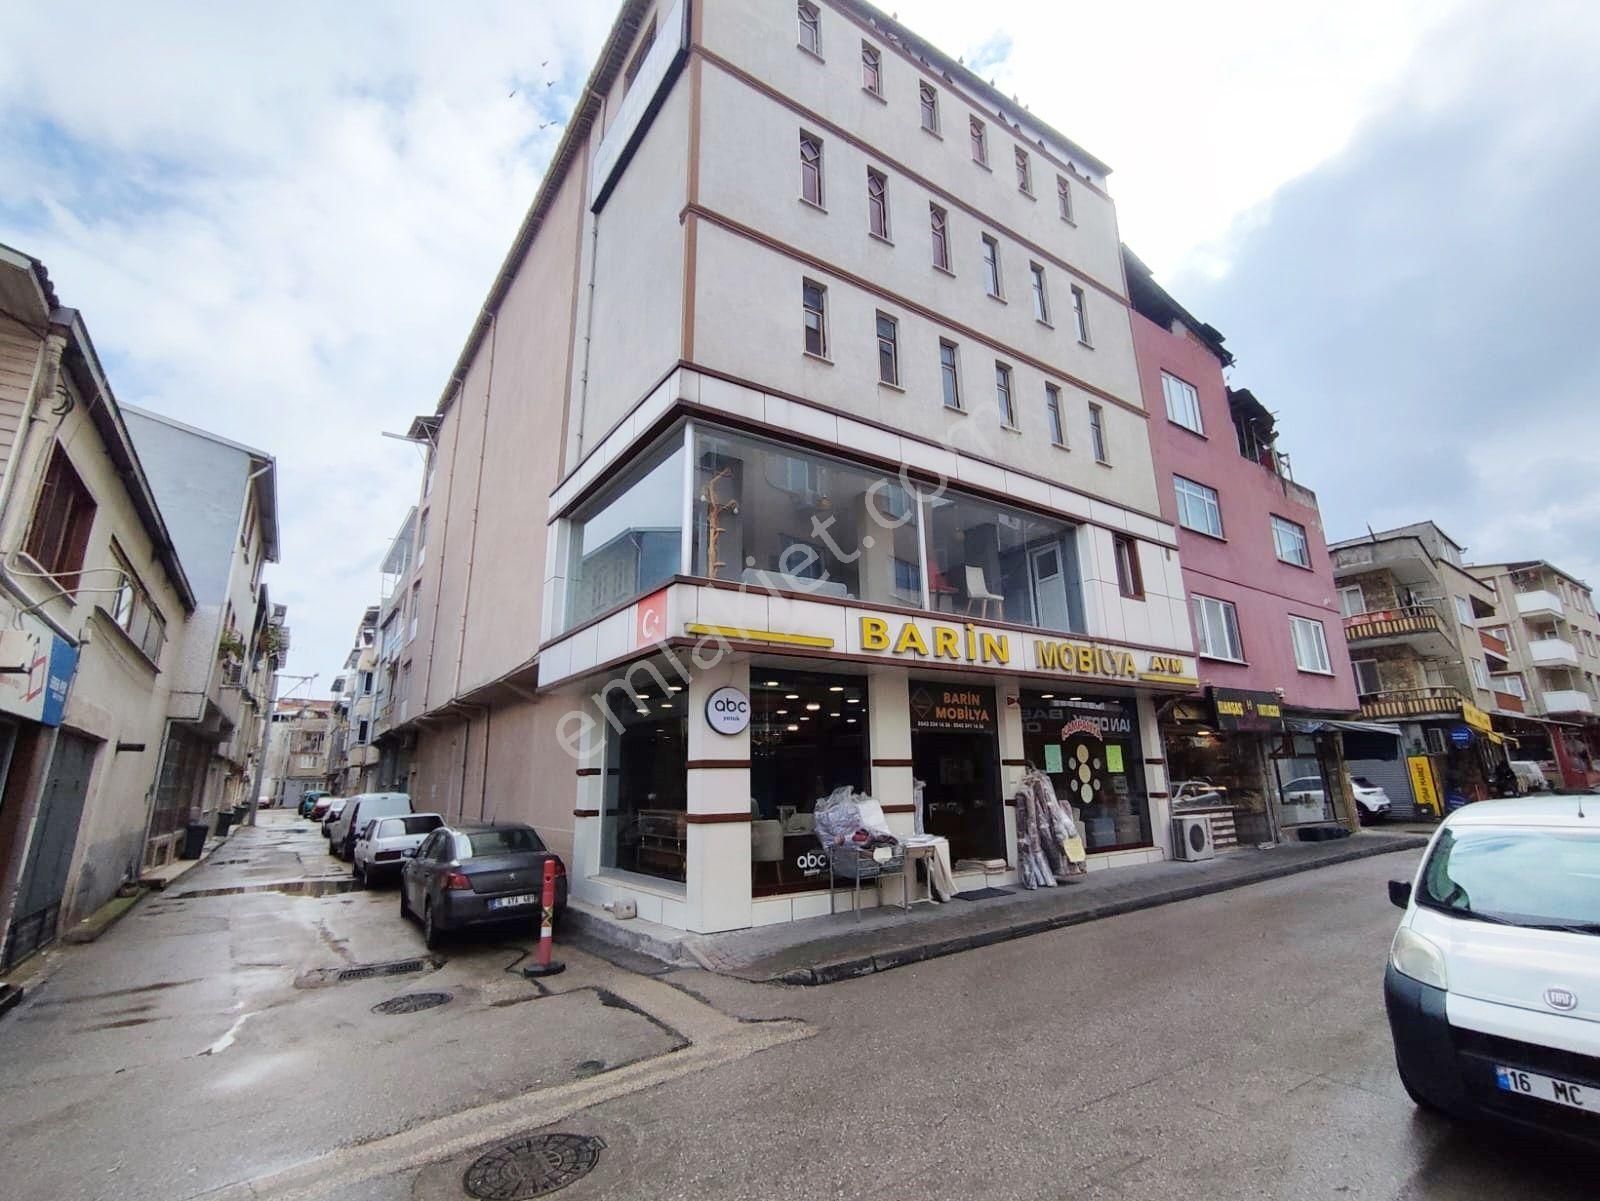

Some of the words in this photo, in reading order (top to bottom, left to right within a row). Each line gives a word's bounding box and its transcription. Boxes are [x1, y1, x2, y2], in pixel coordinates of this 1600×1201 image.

[858, 616, 1010, 664] BARİN
[1034, 639, 1137, 677] MOBİLYA
[1149, 655, 1184, 674] AVM
[714, 698, 747, 713] abc
[943, 691, 981, 705] BARİN
[935, 705, 989, 720] MOBİLYA
[797, 852, 827, 868] abc
[1509, 1071, 1532, 1092] 16
[1551, 1080, 1584, 1105] MC
